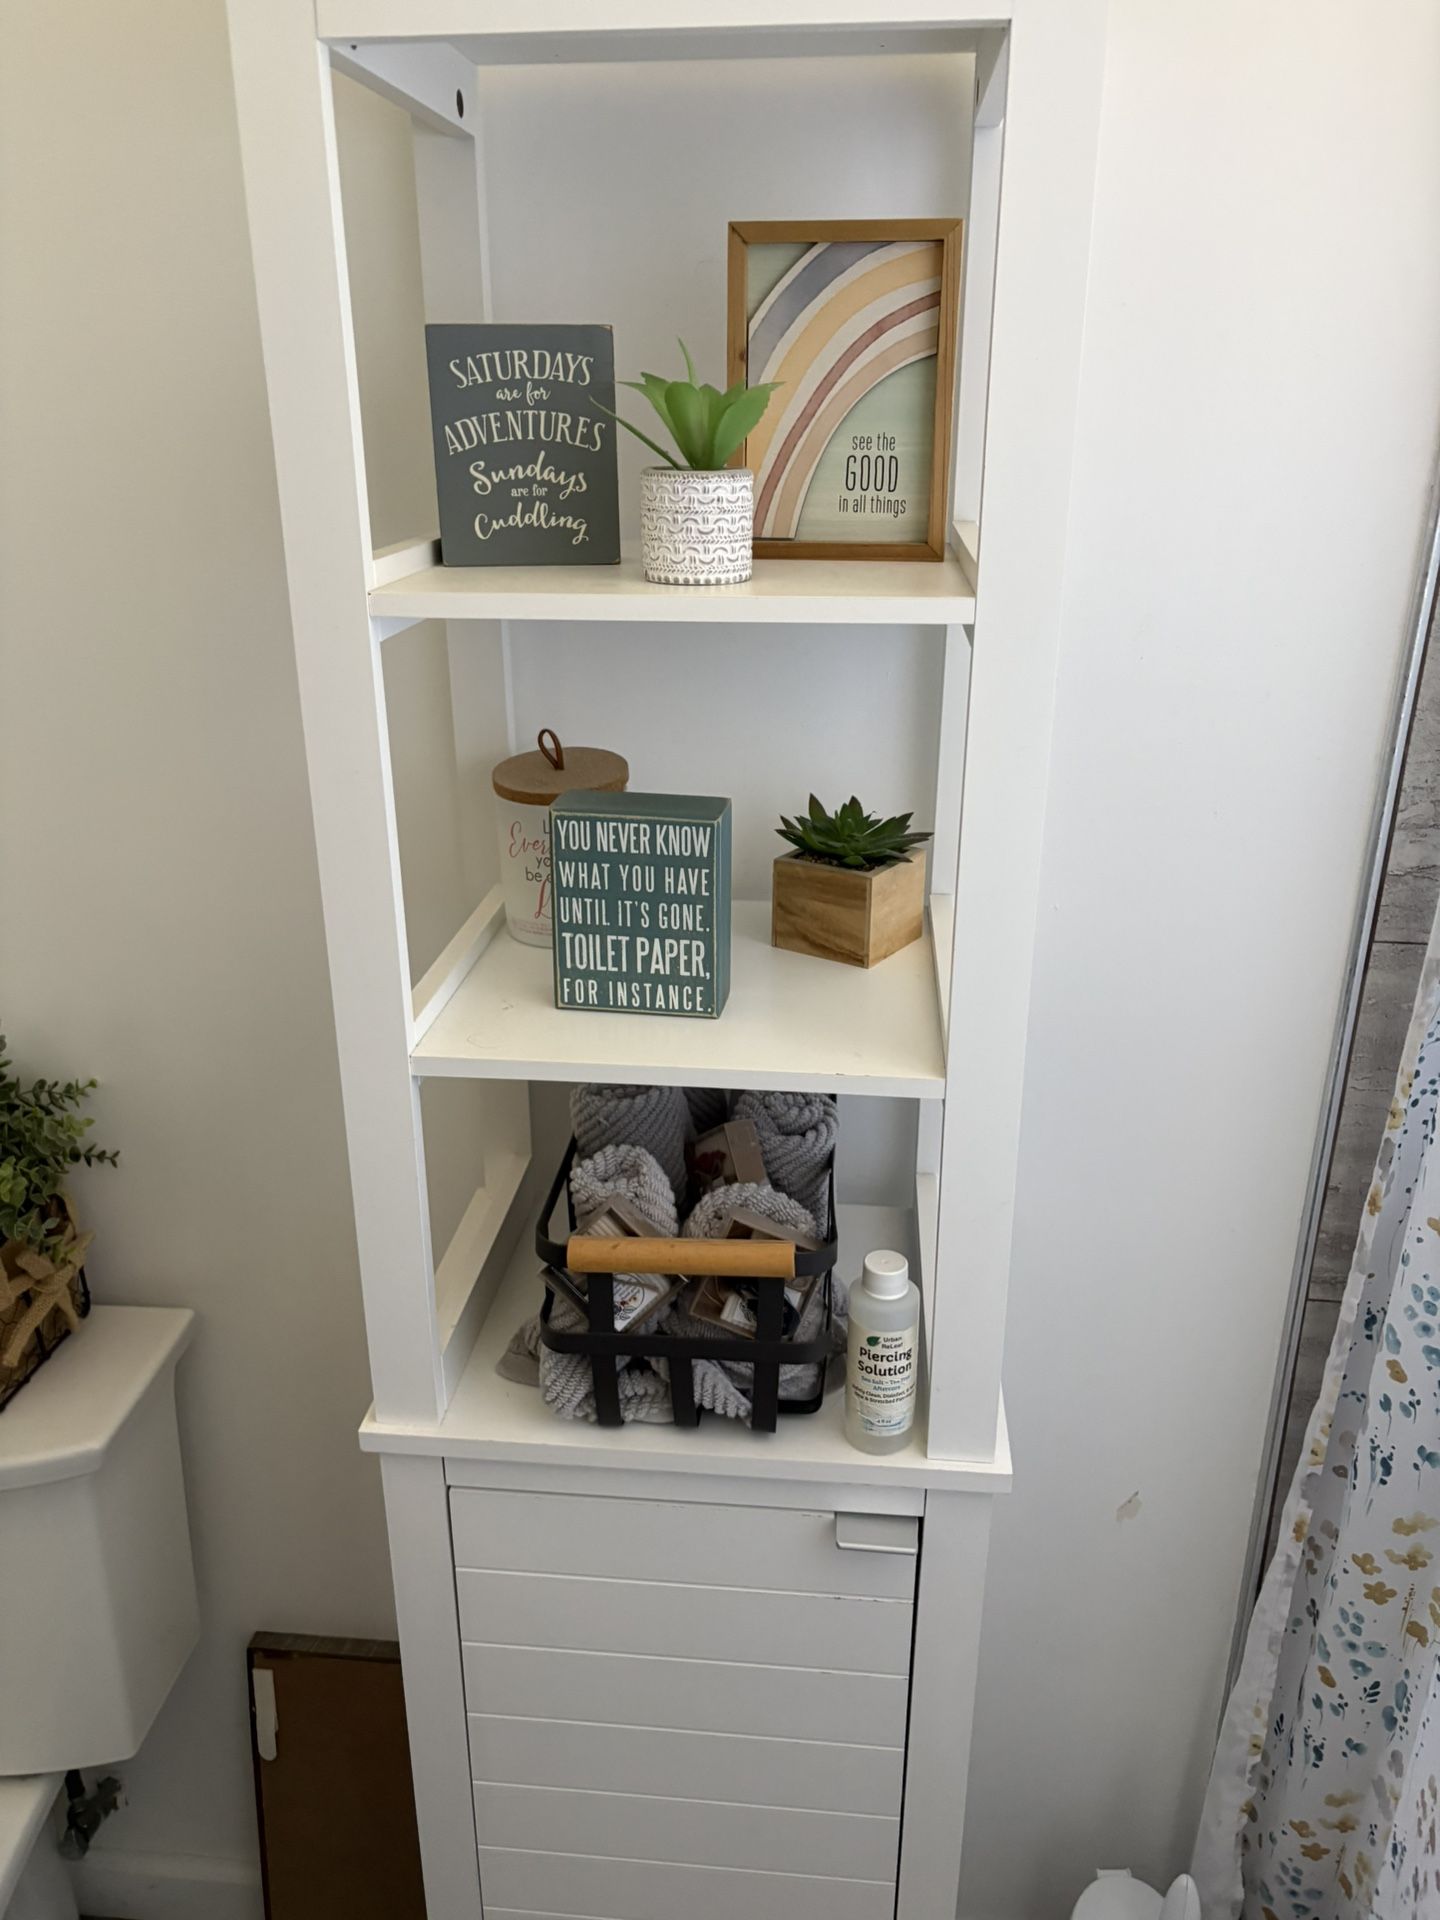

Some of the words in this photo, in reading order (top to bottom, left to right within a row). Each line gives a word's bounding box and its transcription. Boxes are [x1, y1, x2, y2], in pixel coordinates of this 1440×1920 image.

[450, 350, 594, 388] SATURDAYS
[496, 387, 522, 401] are
[526, 381, 551, 406] for
[444, 410, 606, 456] ADVENTURES
[852, 435, 872, 451] see
[877, 432, 896, 451] the
[469, 450, 588, 500] Sundays
[511, 487, 529, 497] are
[533, 484, 548, 497] for
[845, 454, 898, 492] GOOD
[474, 501, 589, 545] Cuddling
[839, 495, 848, 513] in
[852, 495, 866, 513] all
[870, 495, 907, 518] things
[508, 820, 551, 858] Ever
[557, 819, 591, 851] YOU
[596, 821, 650, 855] NEVER
[656, 824, 711, 858] KNOW
[525, 866, 542, 882] be
[536, 856, 551, 868] yo
[558, 861, 610, 890] WHAT
[619, 864, 655, 893] YOU
[664, 867, 710, 896] HAVE
[560, 896, 610, 926] UNTIL
[618, 901, 650, 928] IT'S
[658, 902, 710, 932] GONE.
[561, 932, 630, 972] TOILET
[636, 937, 710, 980] PAPER,
[563, 978, 598, 1005] FOR
[609, 981, 712, 1012] INSTANCE.
[858, 1360, 912, 1377] Solution
[860, 1346, 912, 1362] Piercing
